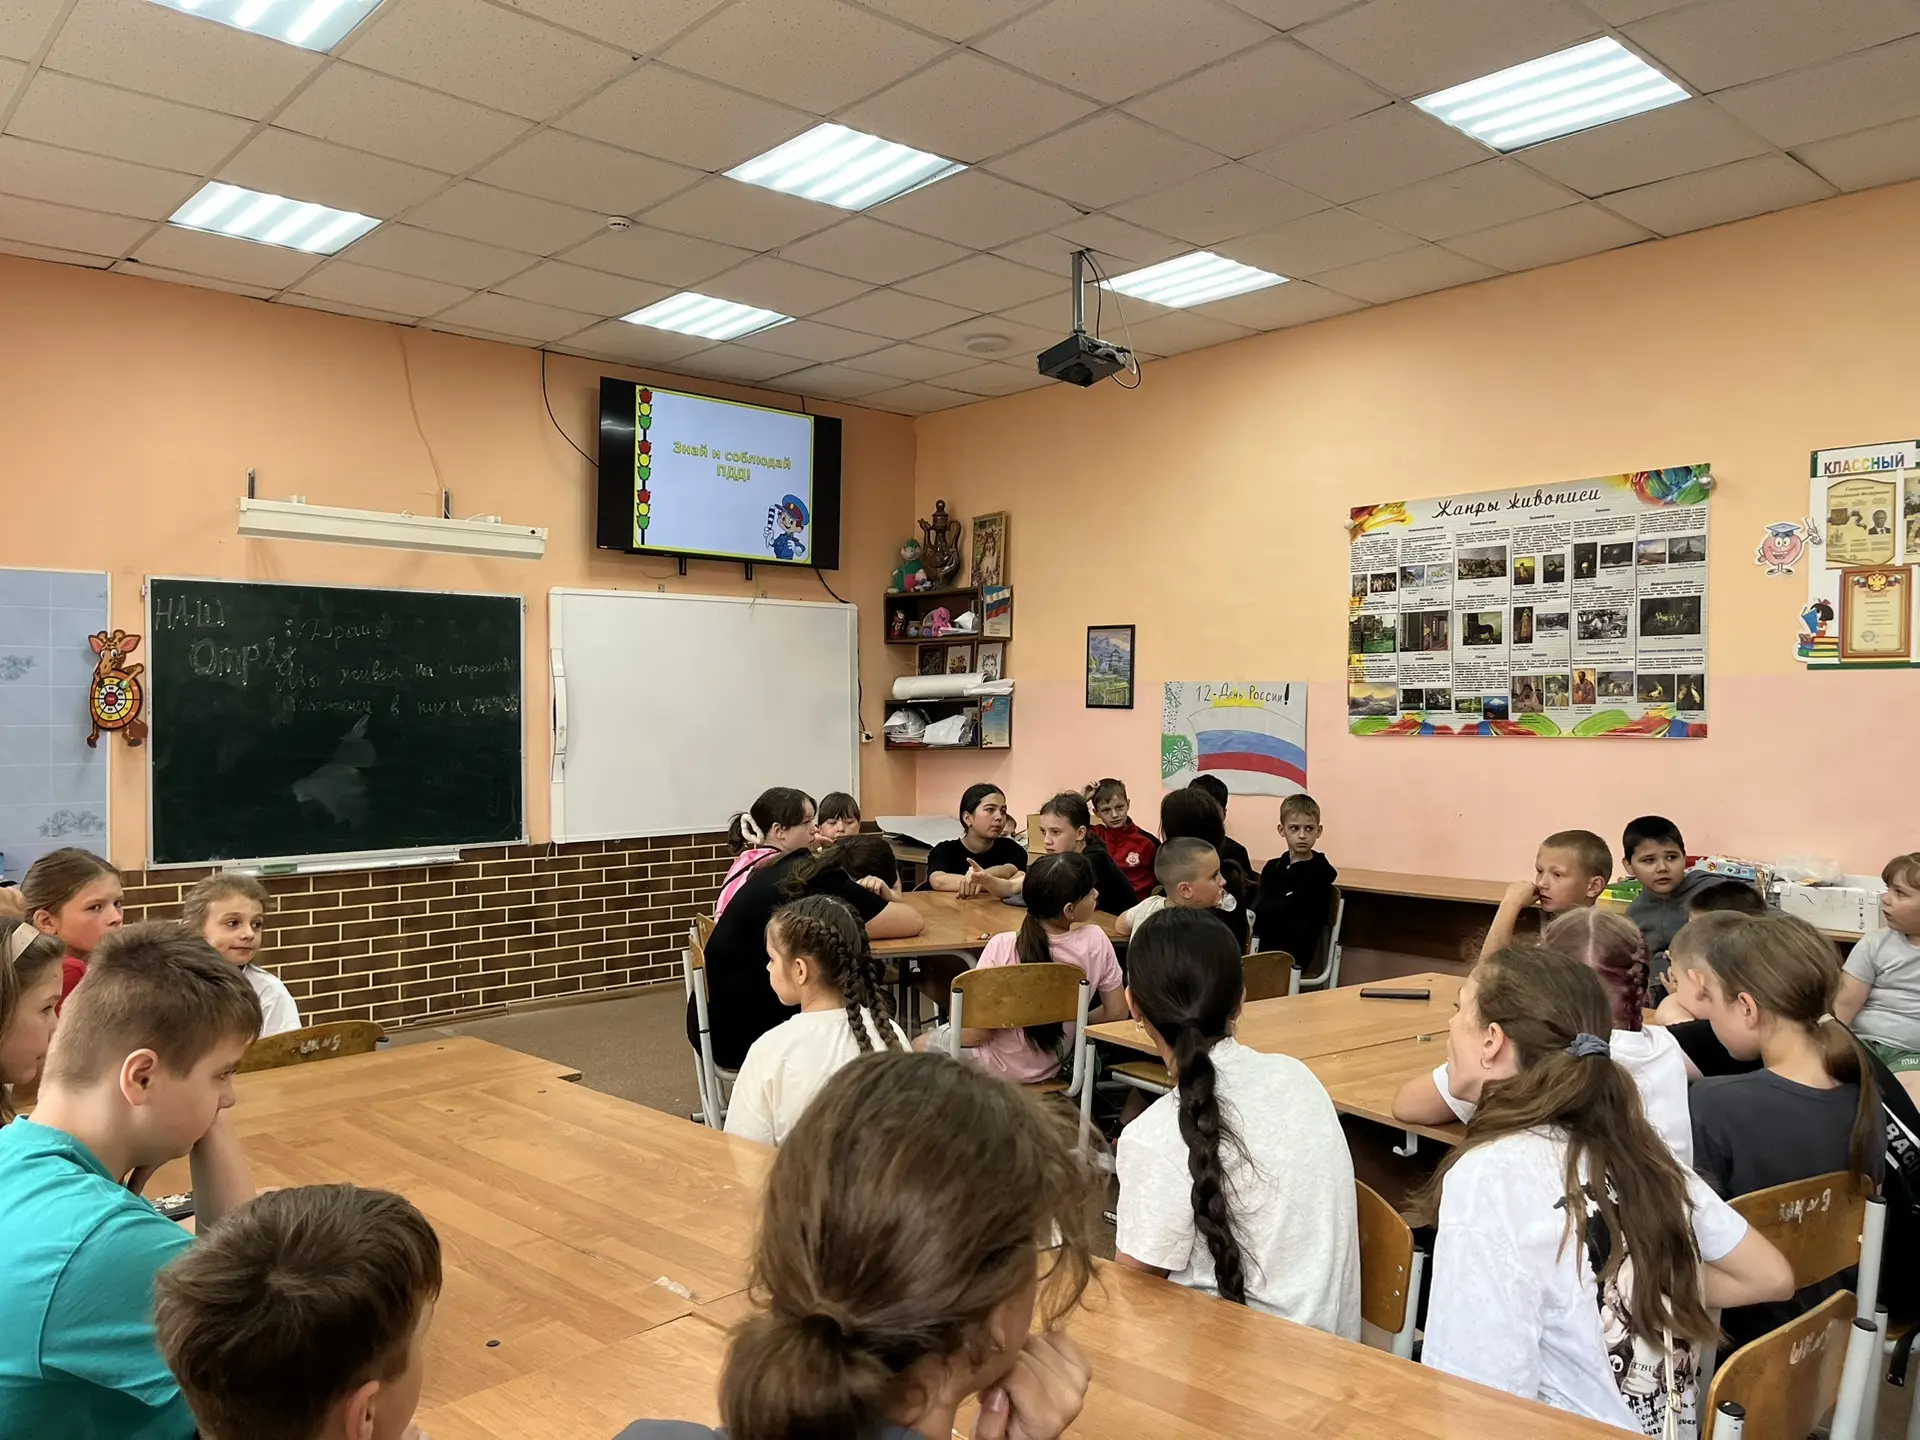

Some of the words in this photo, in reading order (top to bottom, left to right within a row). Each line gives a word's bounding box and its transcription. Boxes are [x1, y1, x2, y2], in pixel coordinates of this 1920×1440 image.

[673, 440, 709, 458] Знай
[711, 448, 721, 460] и
[724, 450, 791, 470] соблюдай
[1823, 451, 1905, 475] КЛАССНЫЙ
[716, 463, 751, 482] ПДД!
[1431, 499, 1500, 518] Жанры
[1506, 488, 1601, 511] живописи
[1249, 682, 1290, 706] России!
